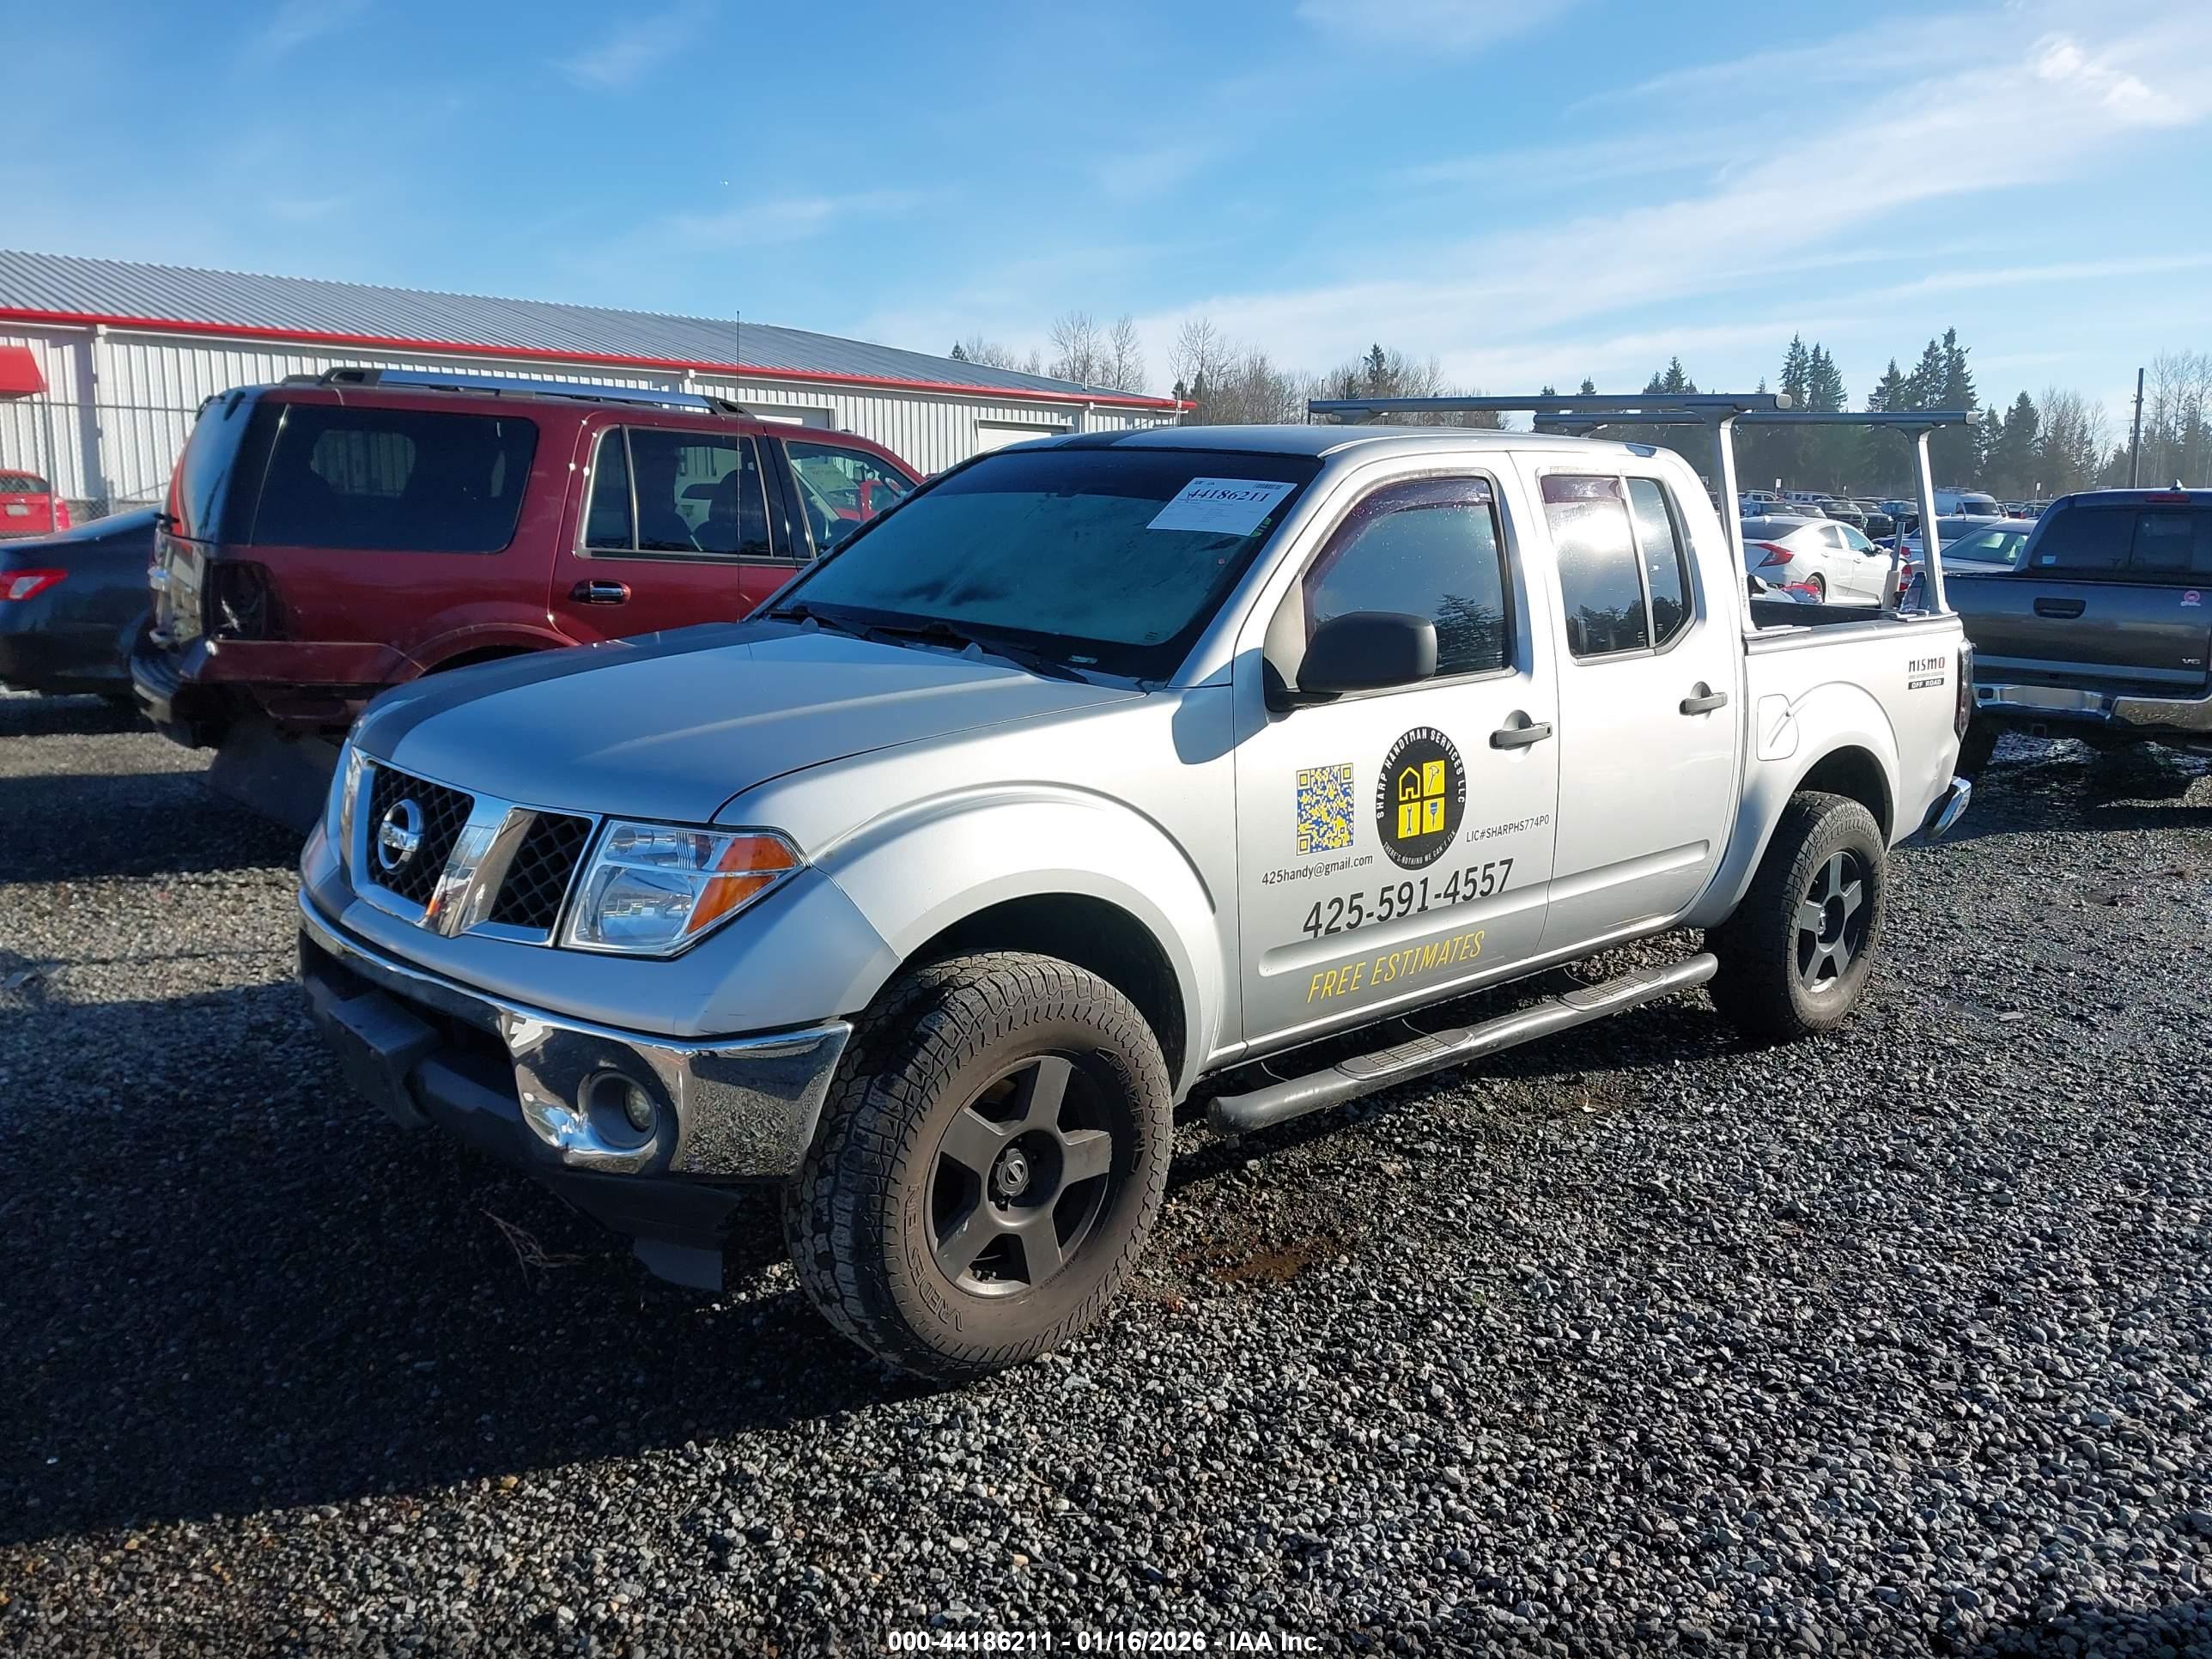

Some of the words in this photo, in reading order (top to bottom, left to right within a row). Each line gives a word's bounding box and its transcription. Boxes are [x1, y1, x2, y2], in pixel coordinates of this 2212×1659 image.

[1188, 489, 1271, 502] 44186211
[1908, 656, 1946, 672] NISMO
[1925, 678, 1942, 688] ROAD
[1376, 773, 1388, 819] SHARP
[1384, 727, 1427, 769] HANDYMAN
[1430, 729, 1463, 775] SERVICES
[1457, 779, 1466, 803] LLC
[1382, 841, 1401, 862] THERE'S
[1425, 854, 1431, 863] WE
[1447, 829, 1456, 842] FIX
[1261, 854, 1373, 885] 425handy@gmail.com
[1303, 858, 1514, 939] 425-591-4557
[1305, 961, 1367, 1004] FREE
[1370, 930, 1485, 986] ESTIMATES
